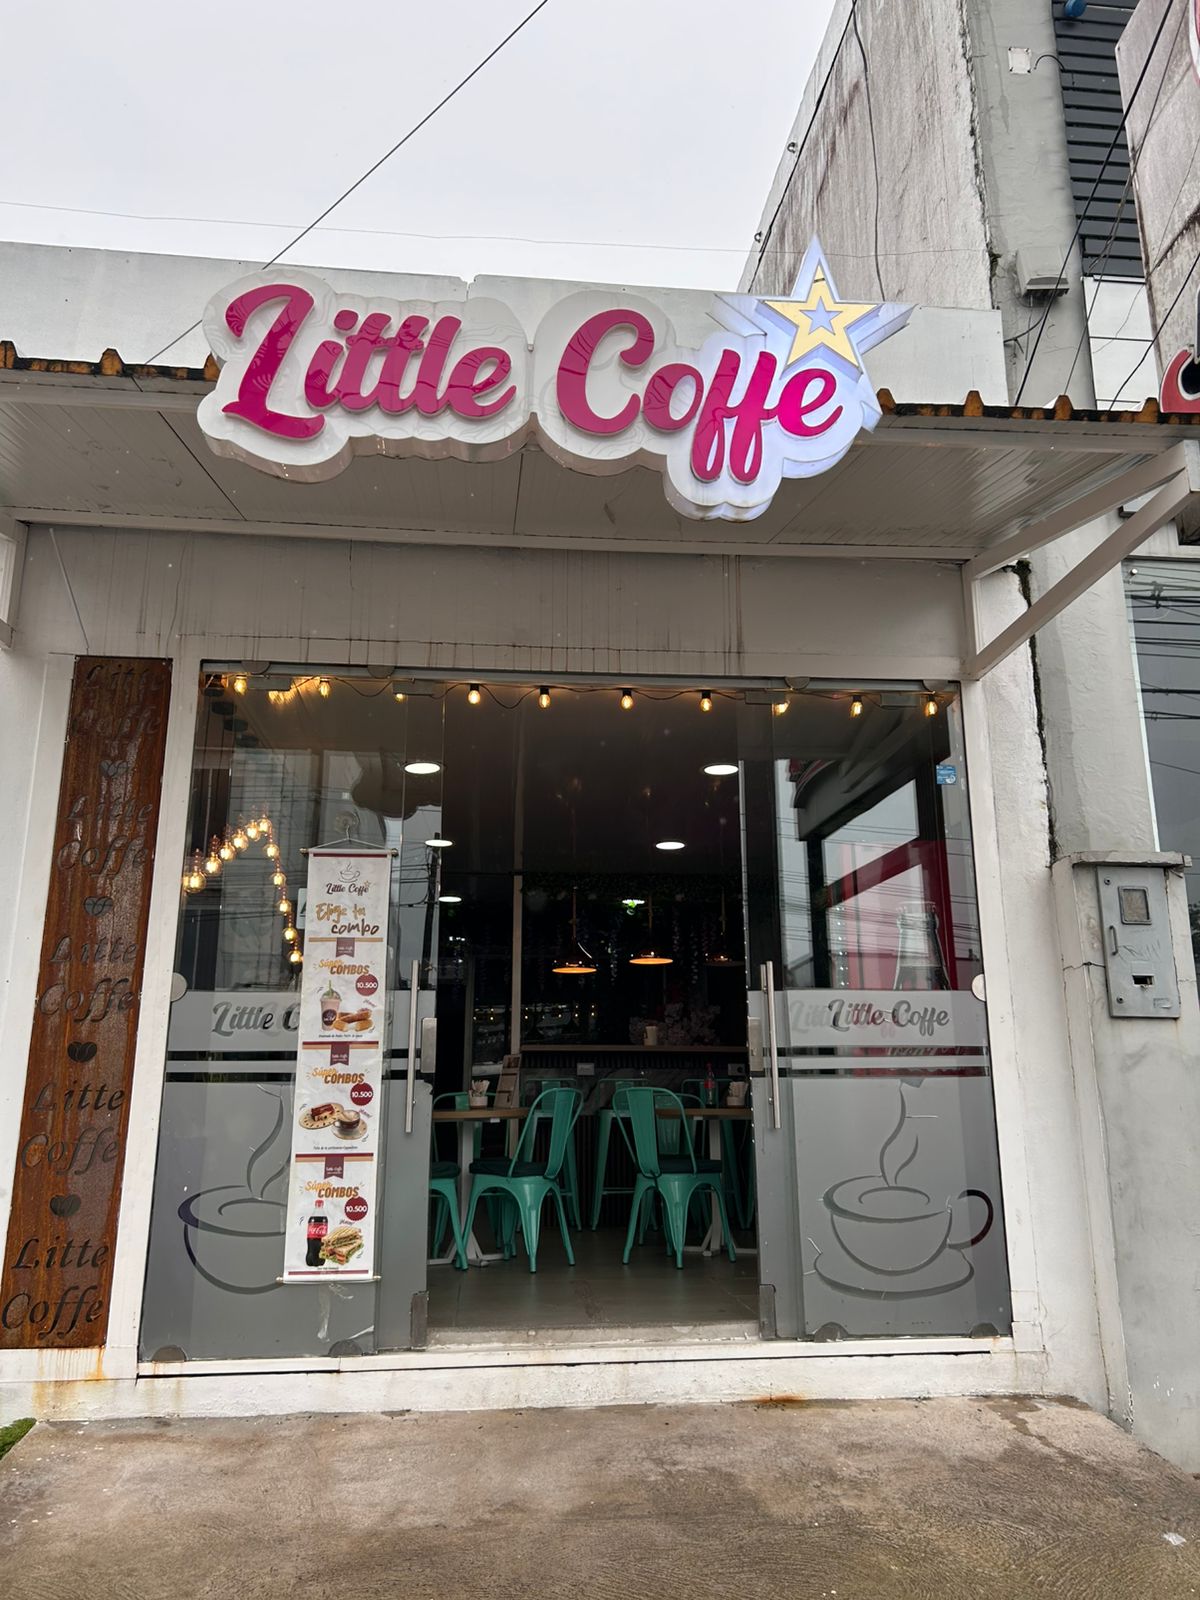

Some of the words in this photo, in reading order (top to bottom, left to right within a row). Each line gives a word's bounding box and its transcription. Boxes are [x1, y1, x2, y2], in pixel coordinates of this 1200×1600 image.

[221, 283, 517, 440] Little
[556, 308, 845, 485] Coffe
[326, 883, 345, 895] Little
[316, 902, 347, 924] Elige
[331, 919, 380, 936] combo
[330, 964, 370, 975] COMBOS
[356, 981, 378, 989] 10.500
[40, 978, 134, 1022] Coffe
[212, 1001, 275, 1037] Little
[828, 999, 884, 1031] Little
[892, 1000, 950, 1036] Coffe
[324, 1073, 365, 1084] COMBOS
[30, 1082, 125, 1113] Litte
[22, 1126, 121, 1176] Coffe
[318, 1186, 360, 1198] COMBOS
[345, 1205, 368, 1213] 10.500
[11, 1238, 110, 1271] Litte
[1, 1285, 103, 1338] Coffe
